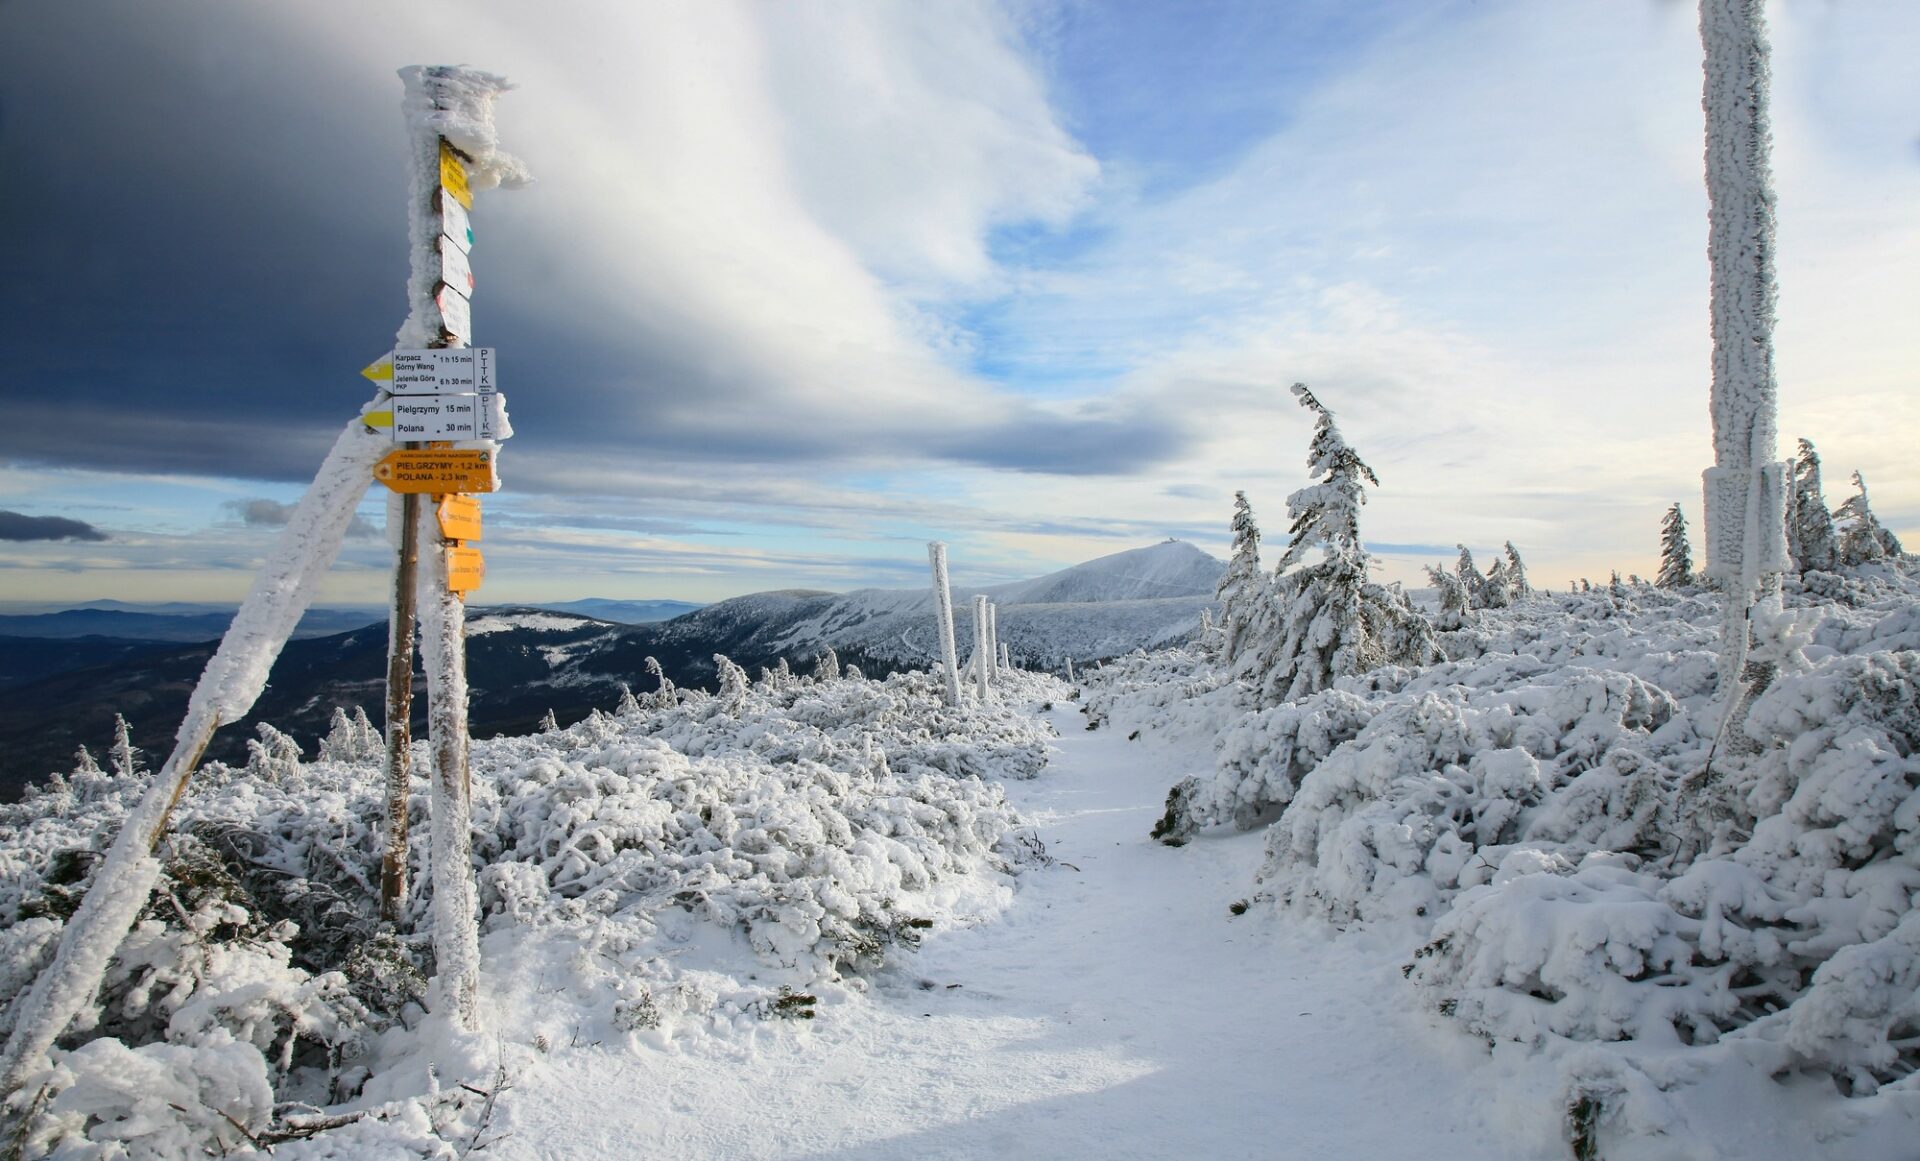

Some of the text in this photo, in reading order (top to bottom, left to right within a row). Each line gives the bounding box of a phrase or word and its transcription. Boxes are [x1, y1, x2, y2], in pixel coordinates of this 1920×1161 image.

[395, 354, 421, 362] Karpacz
[395, 363, 435, 371] Górny Wang
[419, 374, 436, 382] Góra
[397, 405, 440, 415] Pielgrzymy
[398, 424, 425, 432] Polana
[457, 423, 472, 431] min
[396, 462, 454, 470] PIELGRZYMY
[461, 462, 472, 470] 1,2
